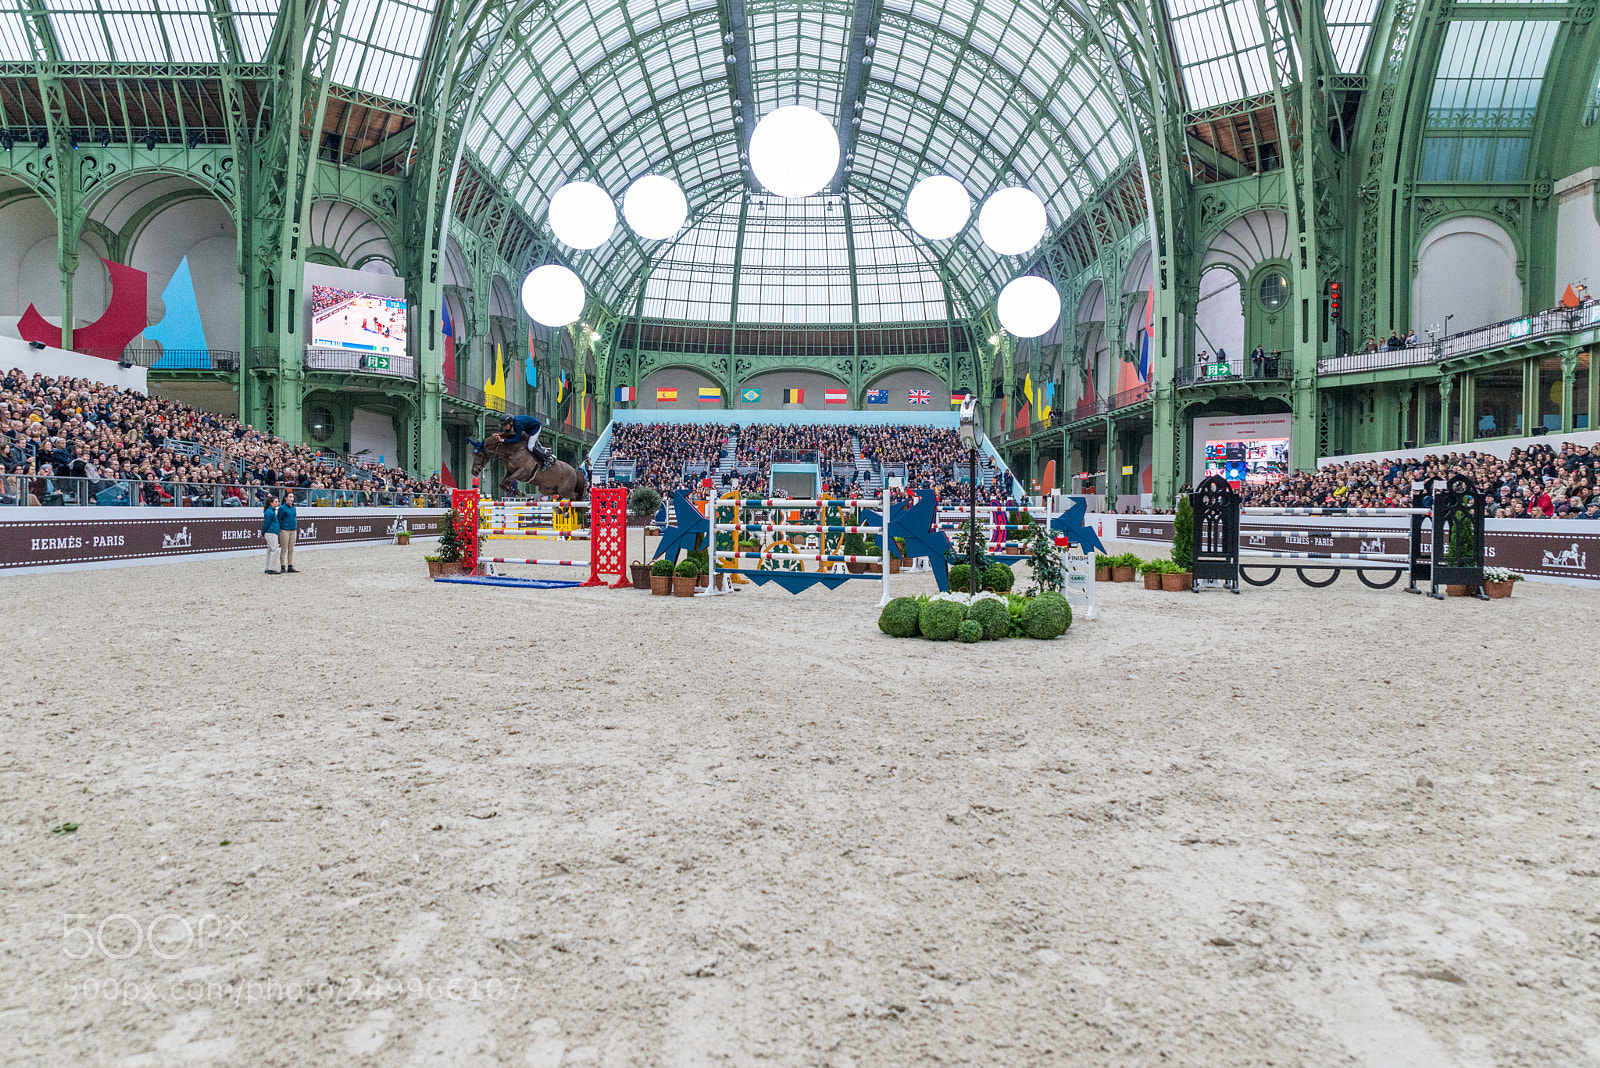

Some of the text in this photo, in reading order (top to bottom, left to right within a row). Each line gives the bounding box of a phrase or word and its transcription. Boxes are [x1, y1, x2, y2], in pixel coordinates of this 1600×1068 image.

[358, 525, 372, 533] PARIS
[222, 529, 252, 540] HERMÈS
[31, 535, 82, 550] HERMÈS
[93, 535, 125, 547] PARIS
[1314, 537, 1334, 547] PARIS
